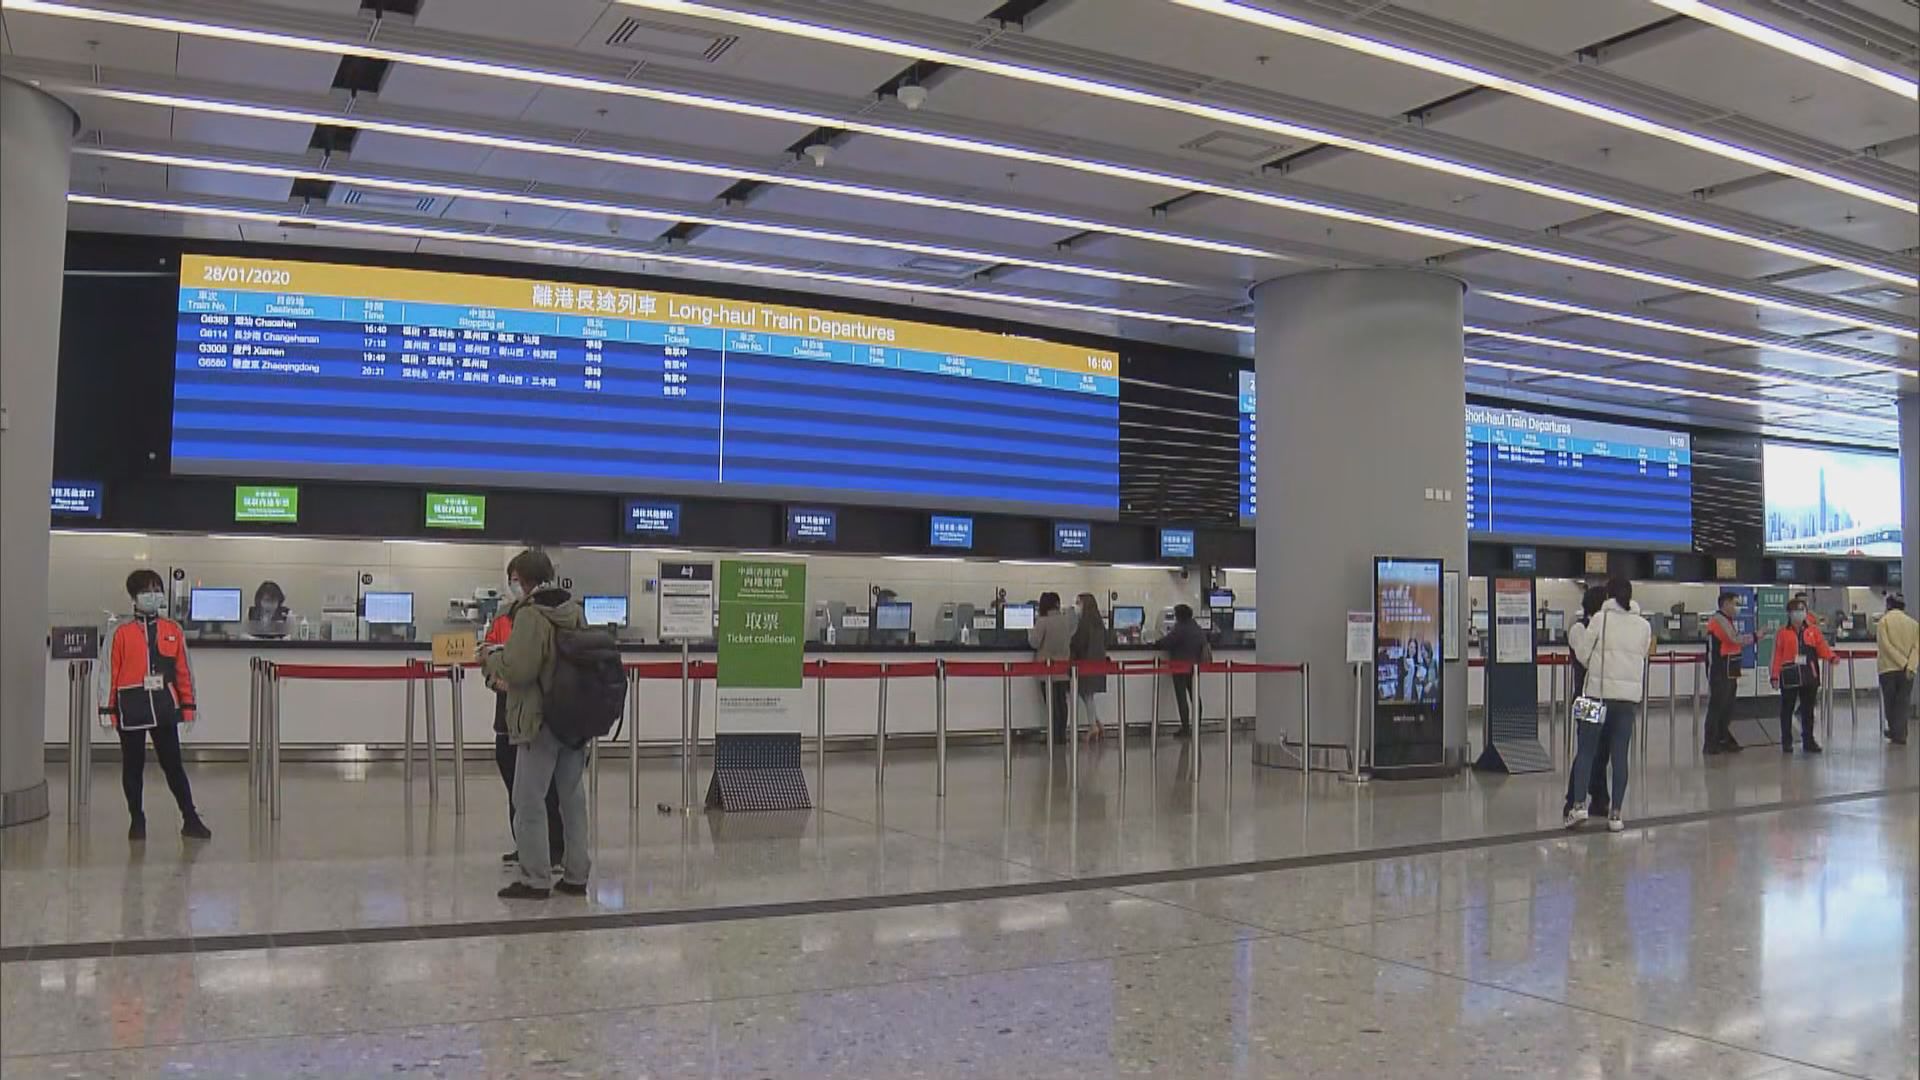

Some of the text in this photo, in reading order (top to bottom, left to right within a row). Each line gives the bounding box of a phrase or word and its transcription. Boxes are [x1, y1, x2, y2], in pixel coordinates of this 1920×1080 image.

[203, 265, 290, 286] 28/01/2020
[187, 300, 227, 311] Train No.
[532, 284, 657, 317] 離港長途列車
[266, 304, 314, 316] Destination
[363, 311, 385, 320] Time
[669, 299, 896, 341] Long-haul Train Departures
[664, 334, 689, 344] Tickets
[253, 345, 285, 356] Xiamen
[1087, 356, 1112, 371] 16:00
[1506, 414, 1527, 429] Train
[1528, 418, 1571, 435] Departures
[745, 611, 779, 631] 取票
[727, 632, 796, 645] Ticket collection
